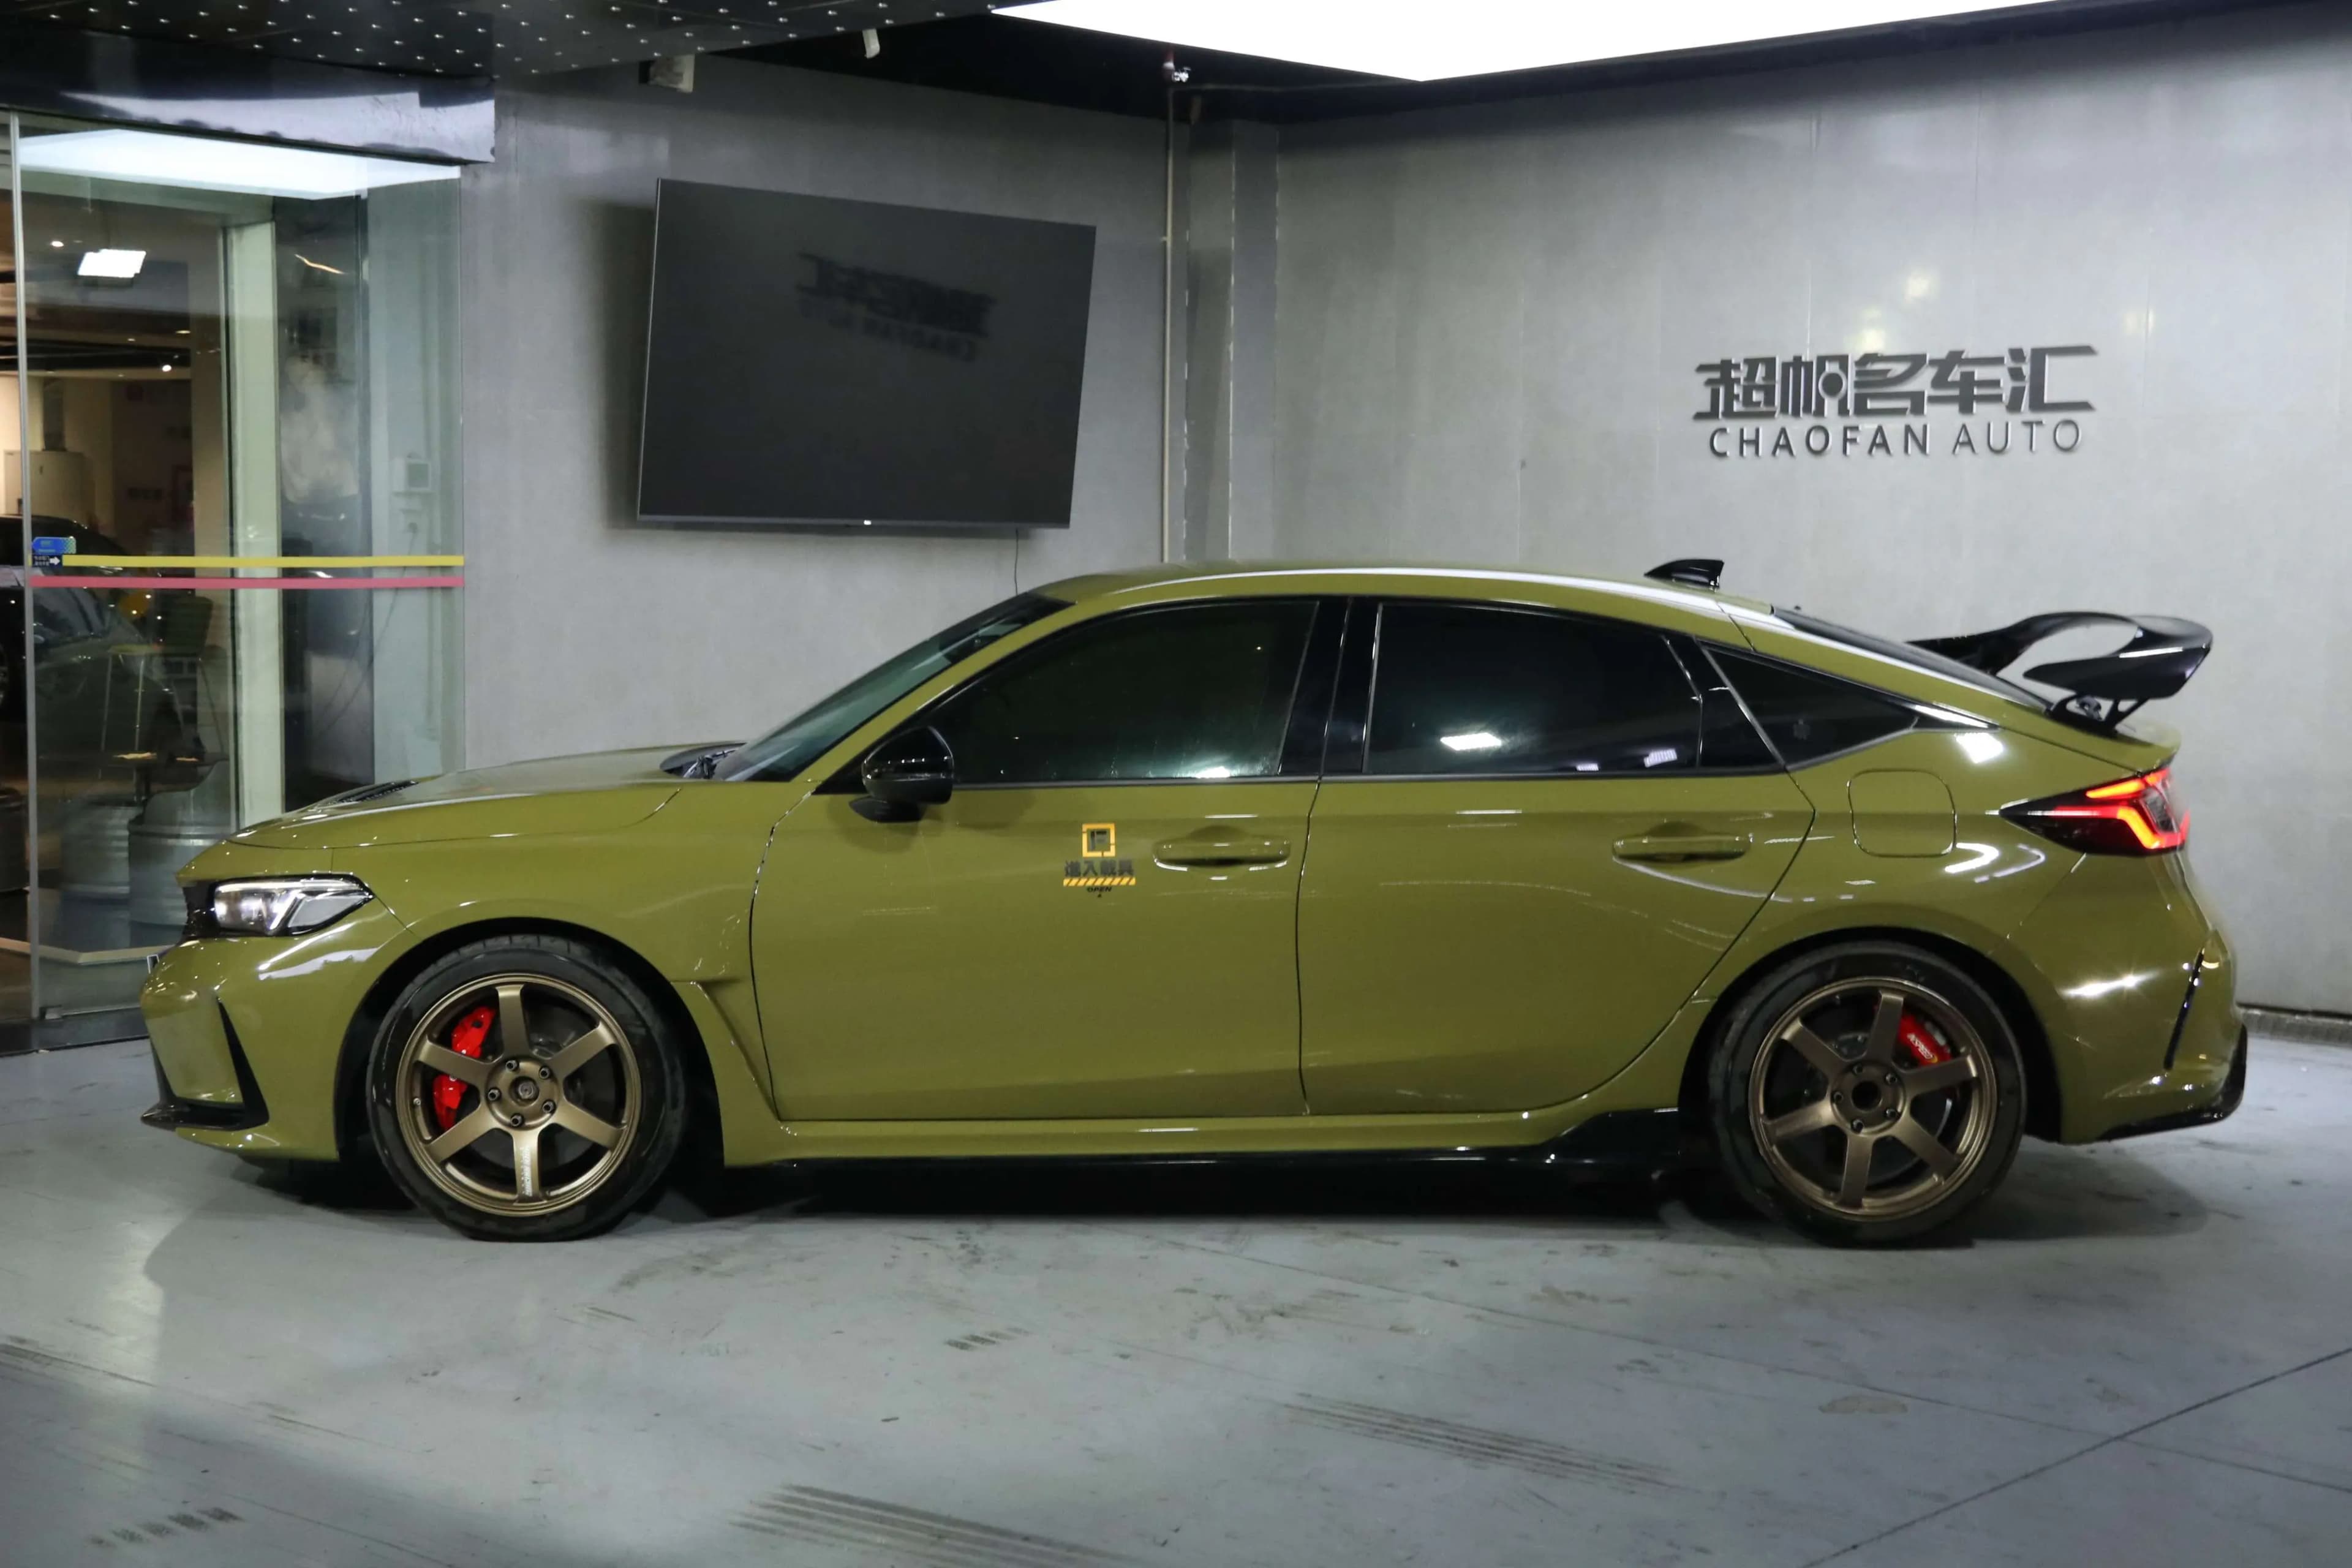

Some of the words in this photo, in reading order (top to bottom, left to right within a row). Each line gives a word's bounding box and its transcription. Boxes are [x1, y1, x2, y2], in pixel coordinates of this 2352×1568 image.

[1693, 345, 2098, 420] 超帆名车汇
[1709, 423, 1929, 458] CHAOFAN
[1952, 418, 2081, 455] AUTO
